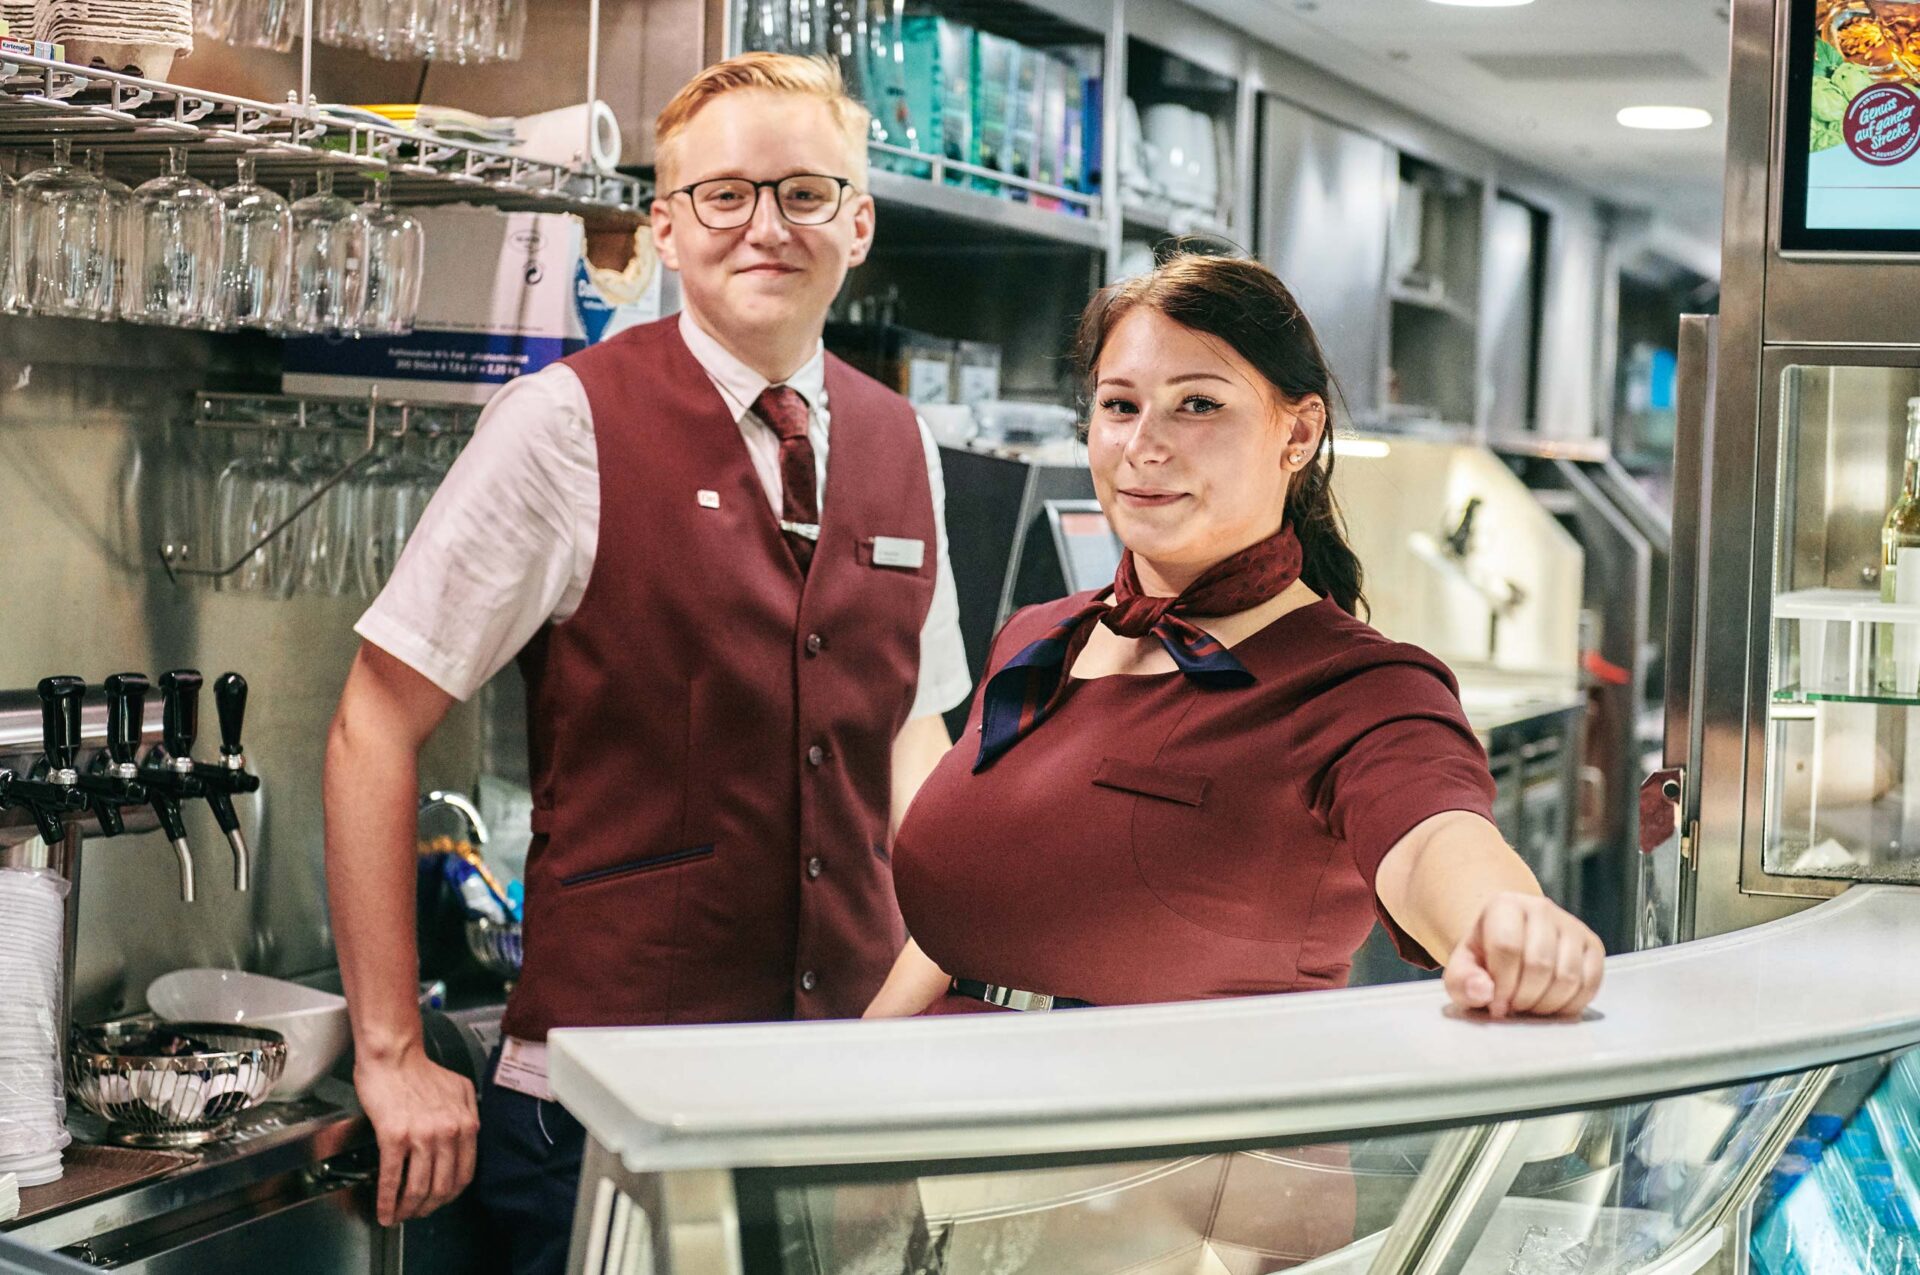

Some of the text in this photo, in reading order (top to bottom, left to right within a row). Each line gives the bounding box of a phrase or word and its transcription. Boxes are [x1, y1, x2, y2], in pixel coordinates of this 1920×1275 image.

[2, 42, 30, 51] Kartenspiel
[1855, 104, 1916, 143] auf ganzer
[1859, 97, 1898, 125] Genuss
[1870, 122, 1911, 150] Strecke
